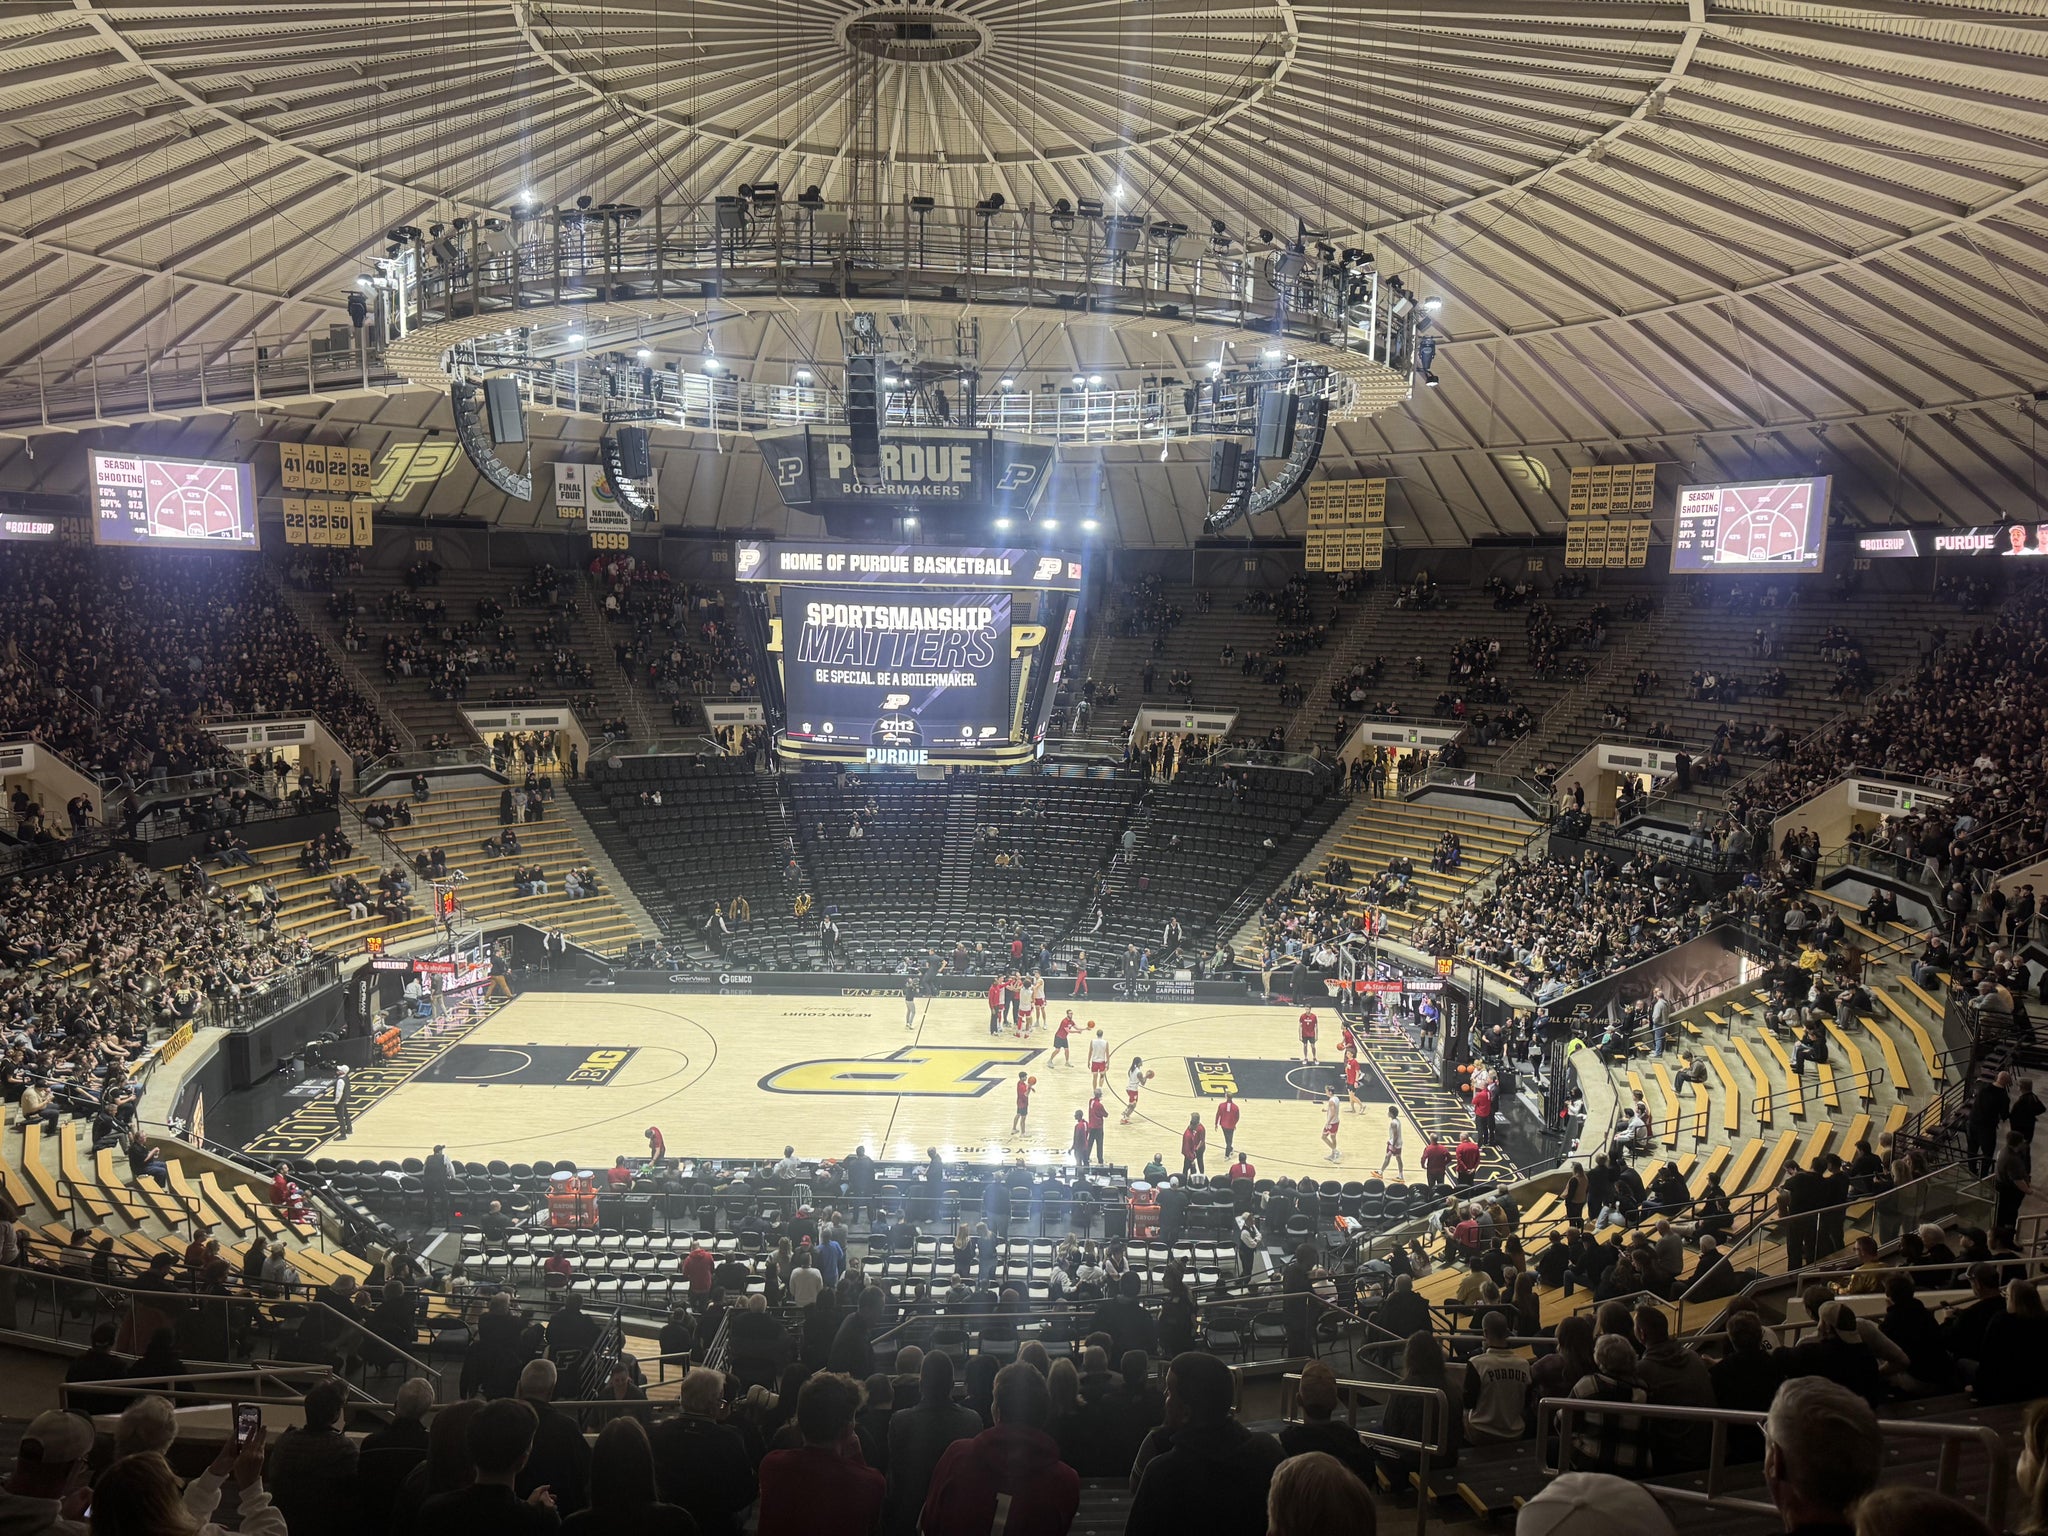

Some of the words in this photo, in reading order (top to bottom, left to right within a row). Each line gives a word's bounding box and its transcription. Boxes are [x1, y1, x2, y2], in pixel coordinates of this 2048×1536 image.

[104, 460, 135, 471] SEASON
[284, 458, 300, 472] 41
[306, 460, 324, 473] 40
[329, 462, 346, 475] 22
[352, 463, 369, 477] 32
[828, 444, 972, 481] PRDUE
[98, 473, 143, 484] SHOOTING
[1688, 492, 1714, 501] SEASON
[101, 510, 118, 519] FT%
[558, 507, 584, 518] 1994
[1682, 504, 1718, 514] SHOOTING
[5, 521, 54, 534] #BOILERUP
[286, 514, 304, 527] 22
[309, 515, 327, 528] 32
[332, 516, 348, 529] 50
[360, 517, 365, 530] 1
[415, 540, 433, 551] 108
[591, 533, 628, 549] 1999
[1860, 538, 1904, 550] #BOILERUP
[1935, 534, 1994, 550] PURDUE
[712, 552, 728, 561] 109
[781, 552, 822, 571] HOME
[827, 554, 846, 571] OF
[850, 555, 909, 573] PURDUE
[914, 556, 1012, 575] BASKETBALL
[1528, 560, 1543, 571] 112
[1854, 559, 1871, 570] 113
[807, 602, 991, 630] SPORTSMANSHIP
[798, 620, 996, 668] MATTERS
[816, 669, 829, 682] BE
[831, 670, 875, 684] SPECIAL.
[877, 672, 890, 686] BE
[891, 673, 899, 686] A
[901, 673, 977, 686] BOILERMAKER.
[962, 726, 972, 737] 0
[866, 748, 928, 765] PURDUE
[1735, 946, 1749, 956] TIME
[1751, 953, 1758, 962] TO
[566, 1050, 628, 1082] BIG
[1488, 1368, 1526, 1382] PURDUE
